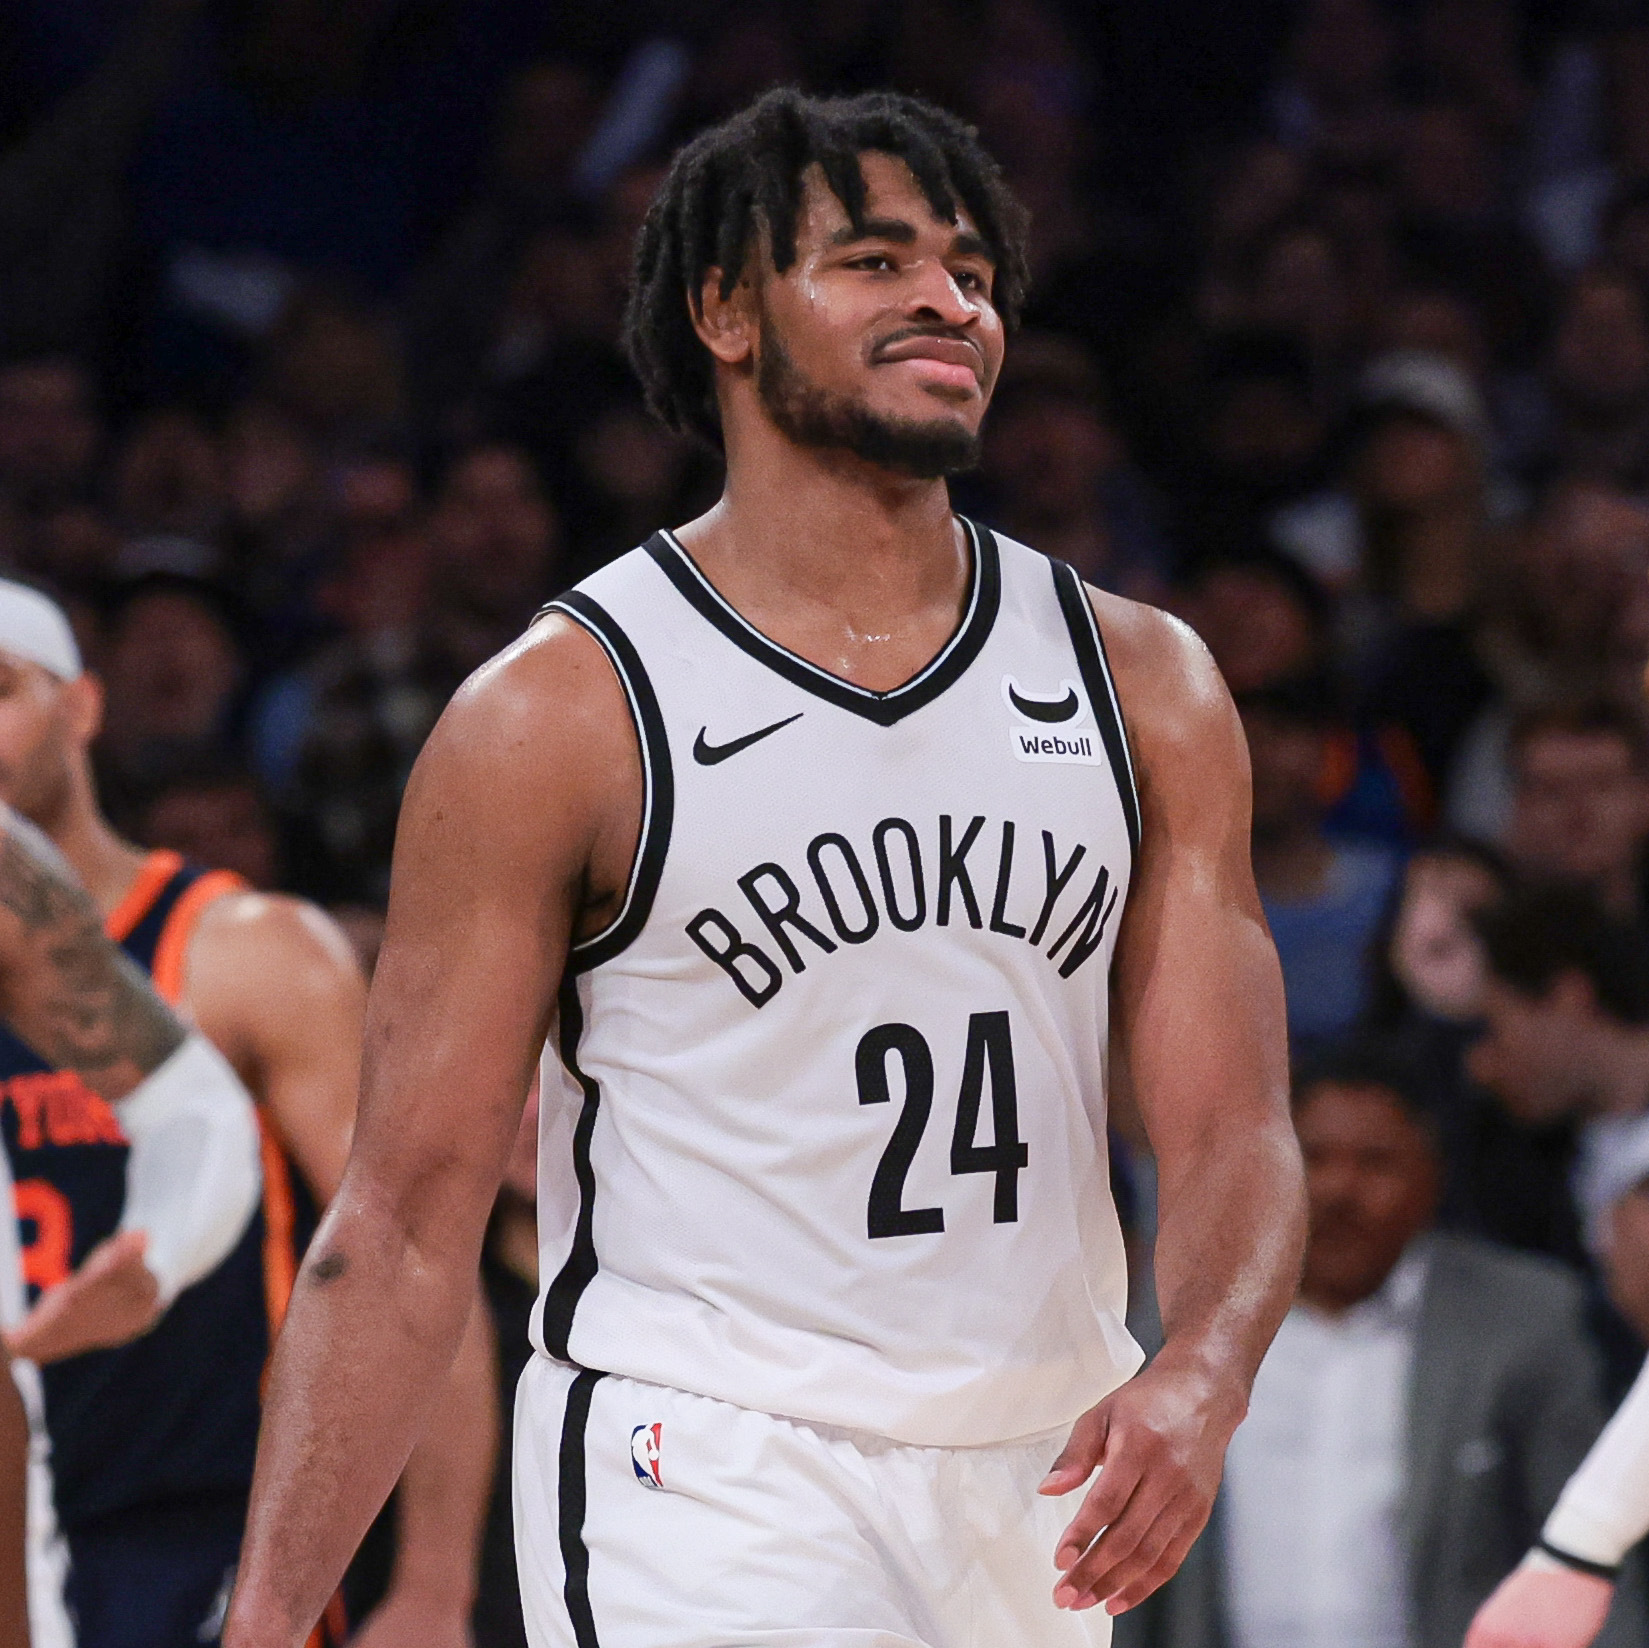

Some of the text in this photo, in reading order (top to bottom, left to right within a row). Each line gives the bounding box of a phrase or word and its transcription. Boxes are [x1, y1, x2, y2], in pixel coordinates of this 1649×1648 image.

[1019, 735, 1092, 757] Webull
[685, 814, 1119, 1010] BROOKLYN
[855, 1010, 1029, 1240] 24
